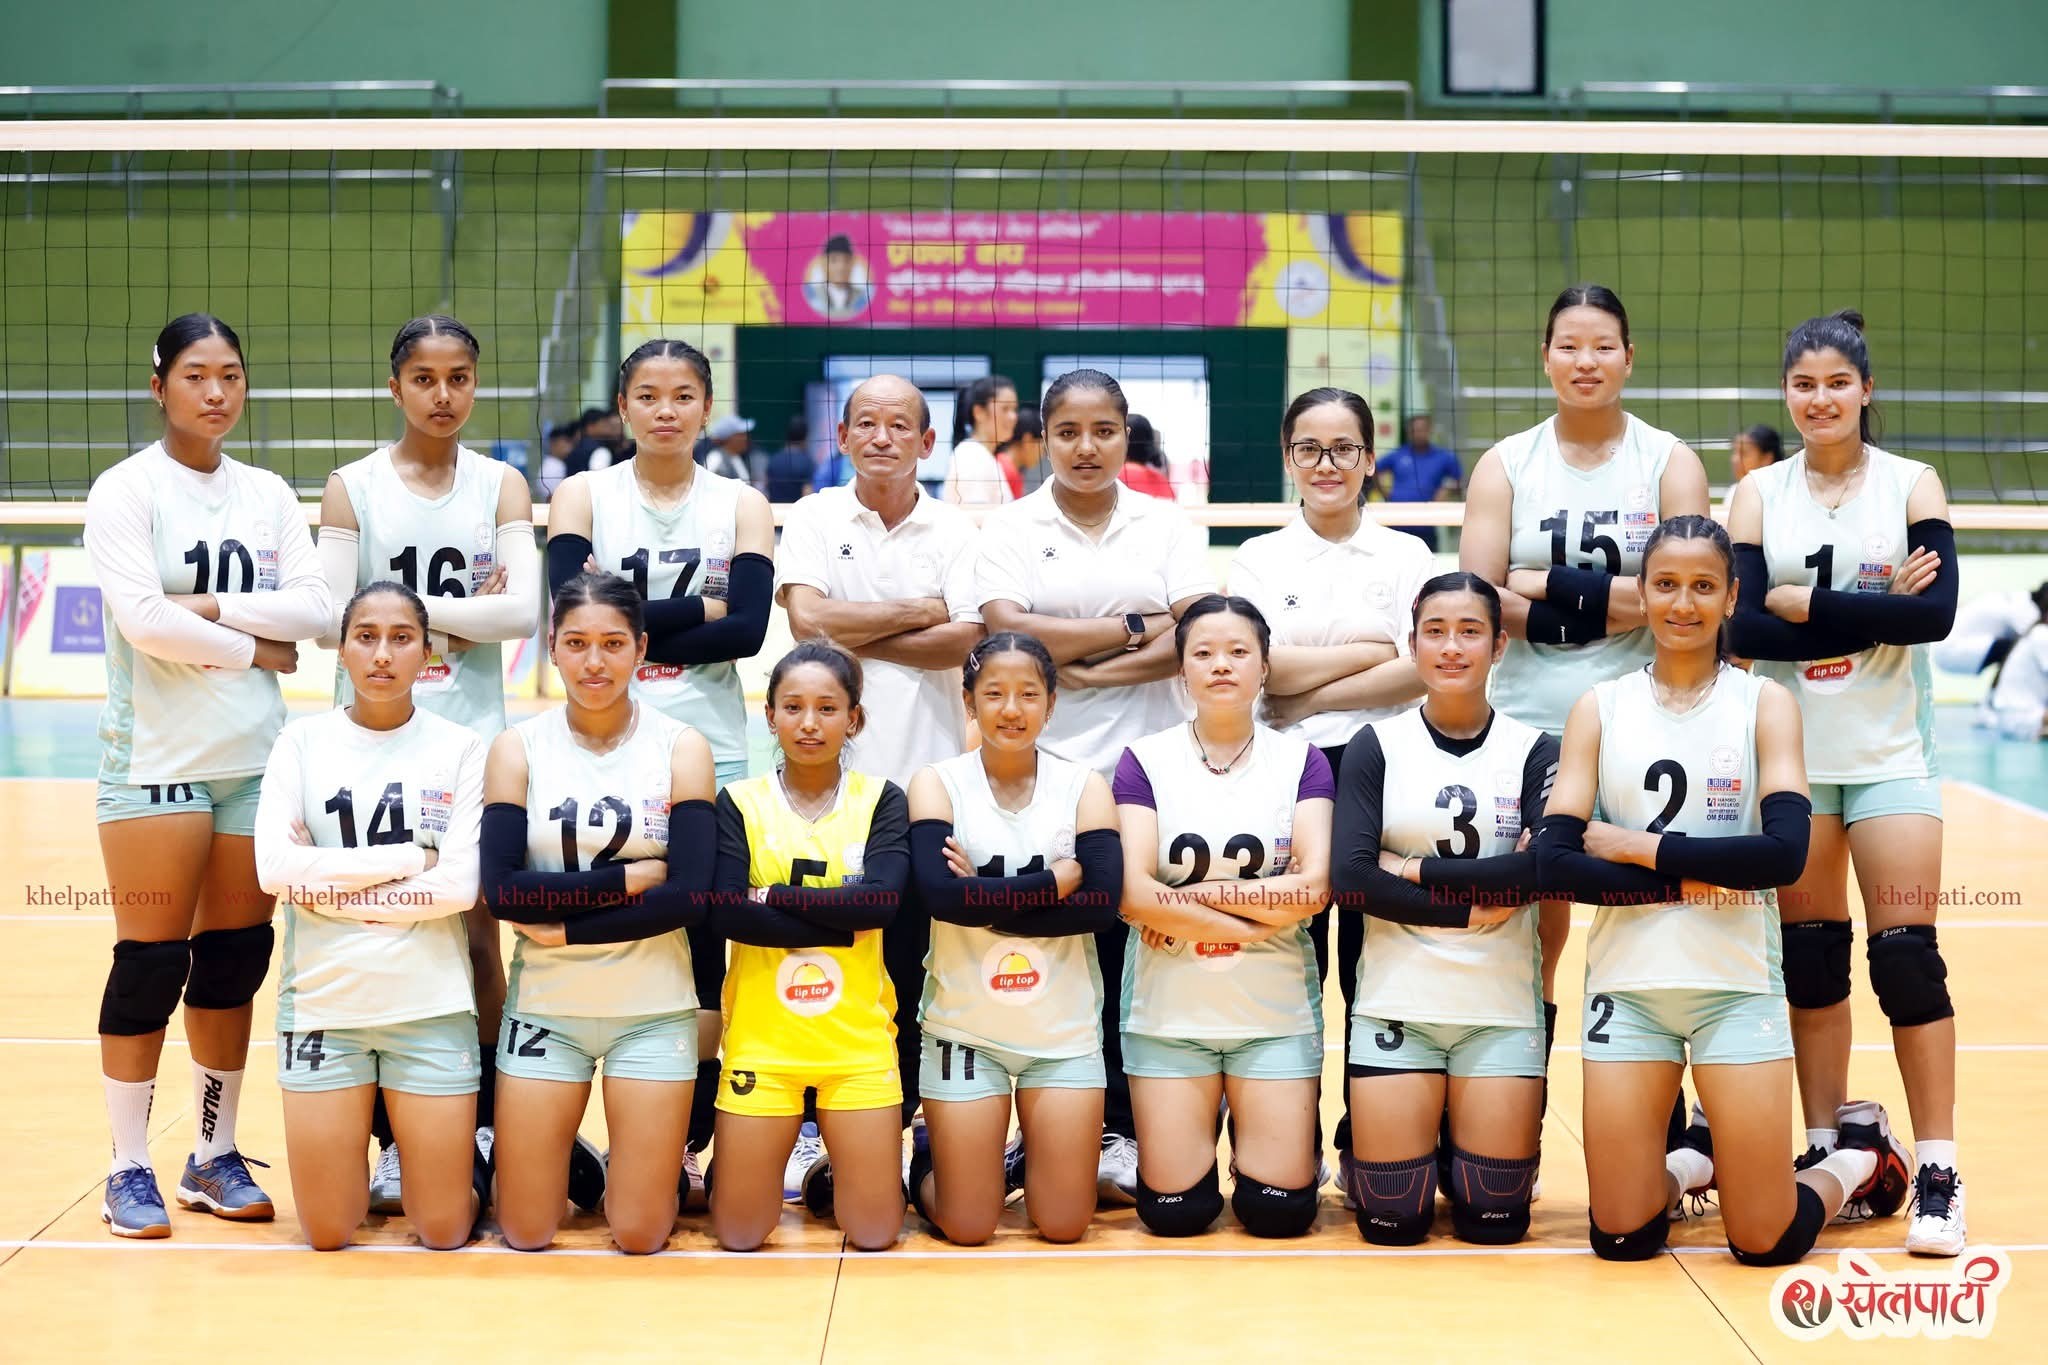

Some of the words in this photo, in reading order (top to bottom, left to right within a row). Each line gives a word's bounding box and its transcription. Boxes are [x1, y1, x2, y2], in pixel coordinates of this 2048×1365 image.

[184, 539, 253, 592] 10
[1540, 510, 1621, 576] 15
[389, 547, 466, 598] 16
[621, 548, 700, 601] 17
[1805, 545, 1833, 590] 1
[416, 671, 426, 679] ip
[428, 667, 445, 677] top
[644, 668, 658, 678] tip
[661, 665, 679, 675] top
[1813, 667, 1827, 677] tip
[1829, 665, 1847, 674] top
[325, 782, 413, 848] 14
[1434, 784, 1480, 860] 3
[1644, 759, 1687, 837] 2
[549, 796, 632, 870] 12
[1169, 833, 1265, 885] 23
[794, 988, 808, 998] tip
[810, 985, 829, 996] top
[999, 976, 1014, 986] tip
[1016, 974, 1034, 984] top
[507, 1017, 551, 1057] 12
[1375, 1018, 1404, 1051] 3
[1587, 993, 1615, 1044] 2
[283, 1030, 326, 1071] 14
[936, 1040, 976, 1080] 11
[202, 1073, 223, 1143] PALACE
[1378, 1220, 1398, 1228] asics
